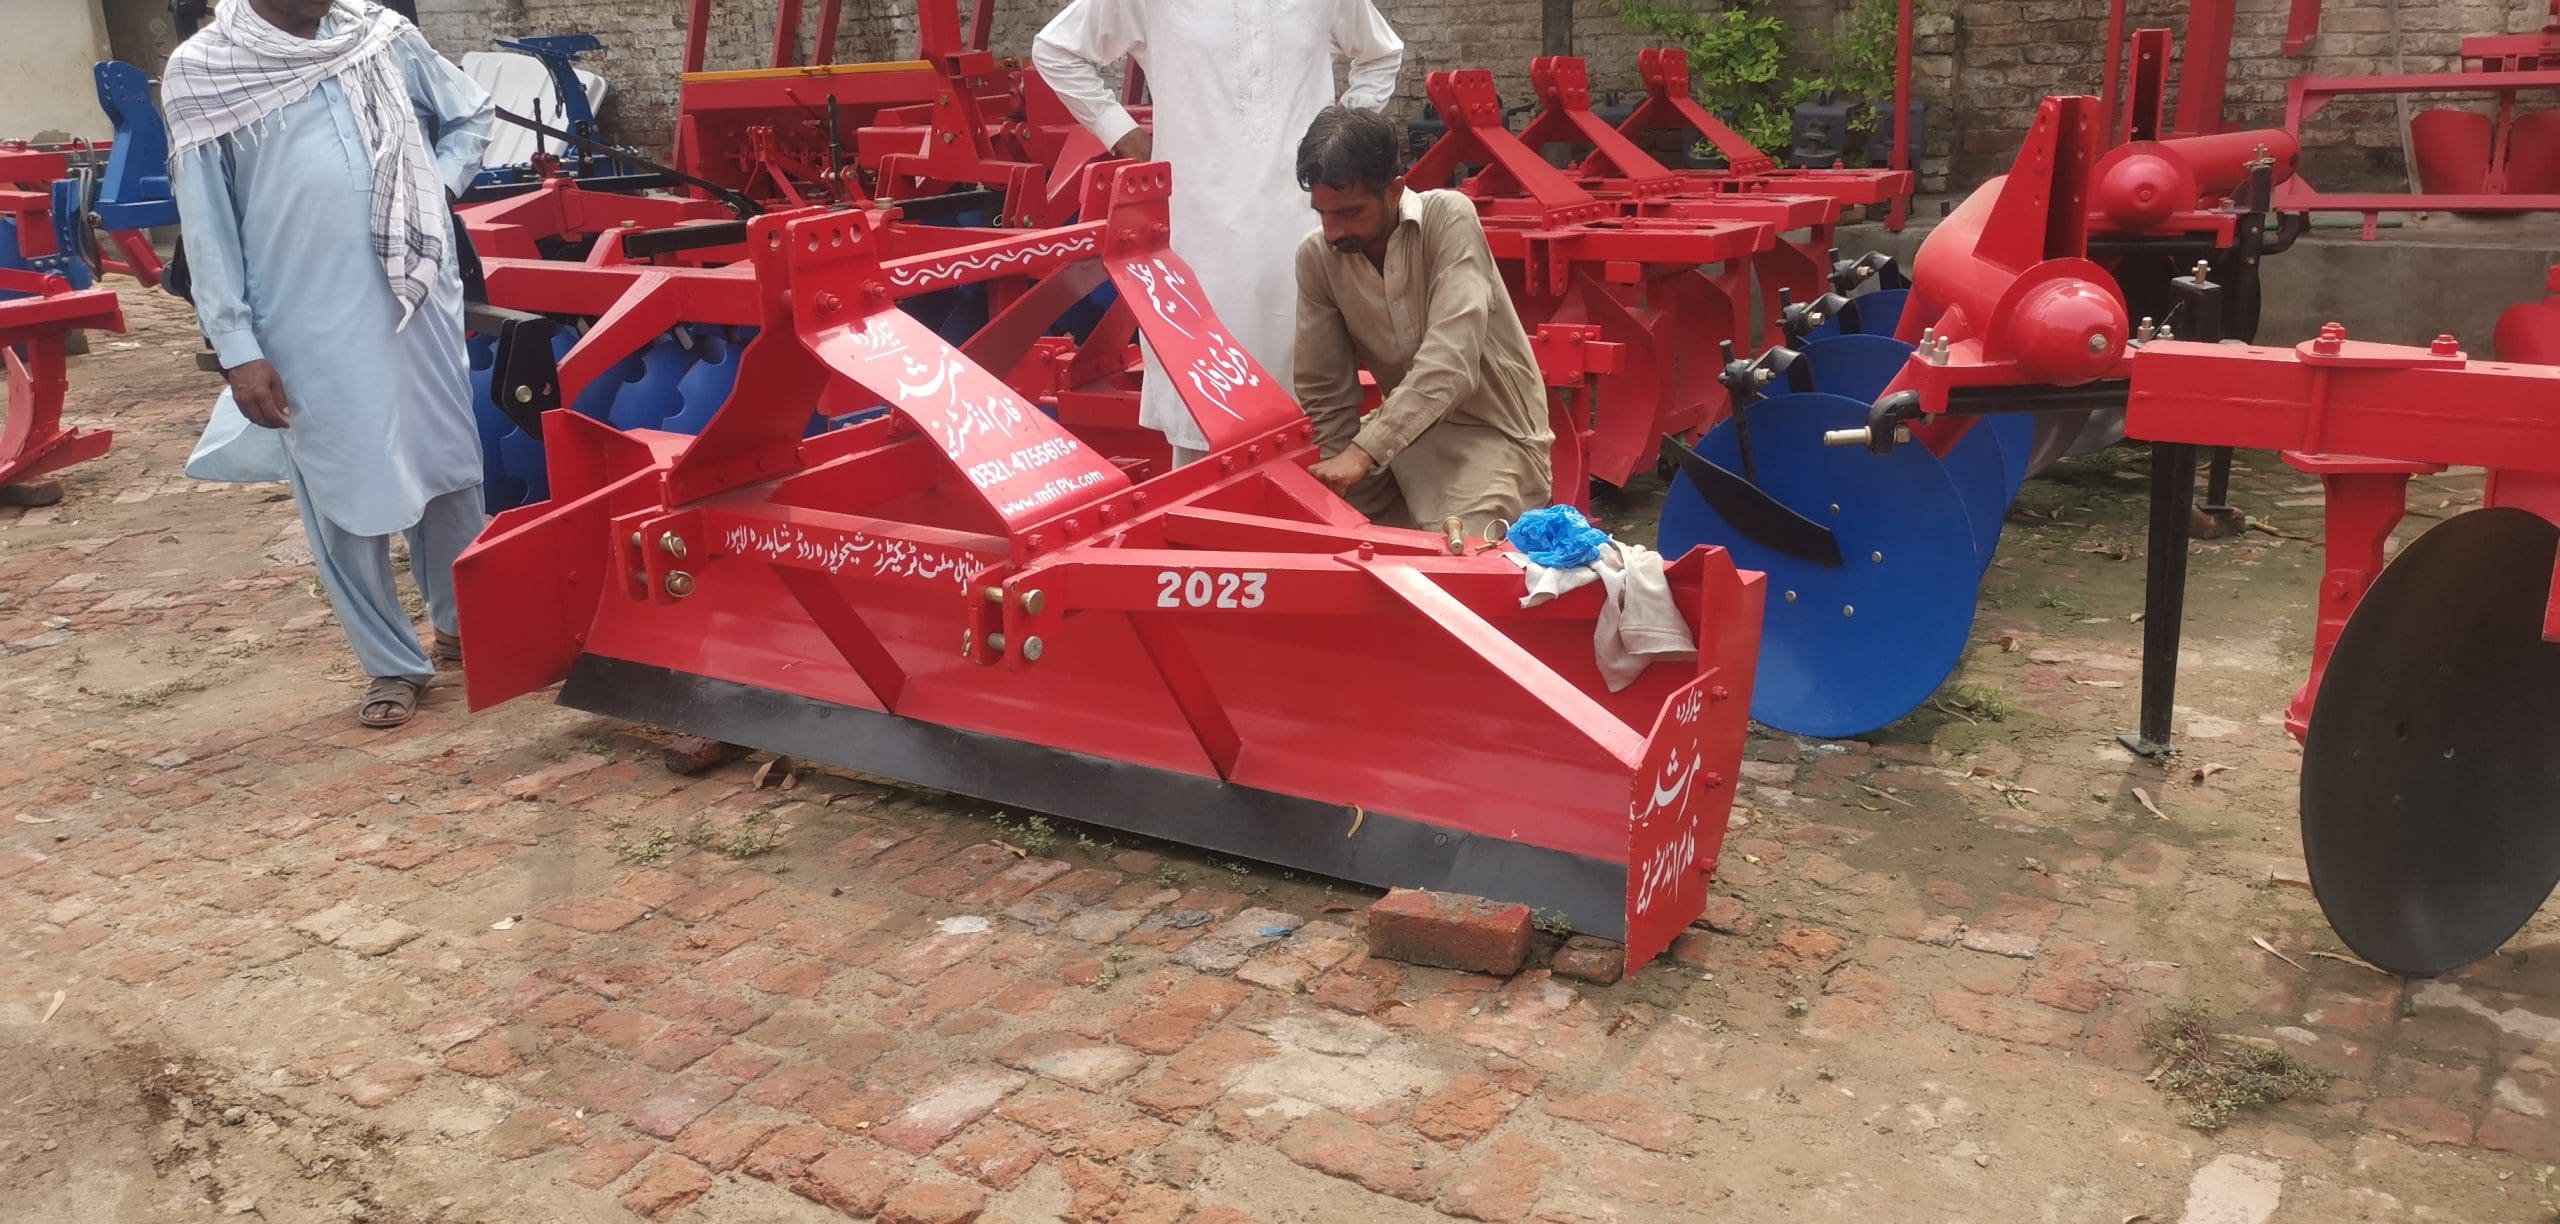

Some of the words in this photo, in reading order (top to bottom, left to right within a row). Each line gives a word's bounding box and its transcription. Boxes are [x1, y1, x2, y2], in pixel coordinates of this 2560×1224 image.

[1207, 331, 1260, 387] ڈیری
[1187, 358, 1245, 421] فارم
[986, 394, 1022, 440] فارم
[724, 525, 748, 555] لاہور
[750, 523, 792, 560] شاہدرہ
[796, 528, 816, 560] روڈ
[918, 552, 953, 579] ملت
[1157, 571, 1268, 609] 2023
[1674, 814, 1698, 903] فارم
